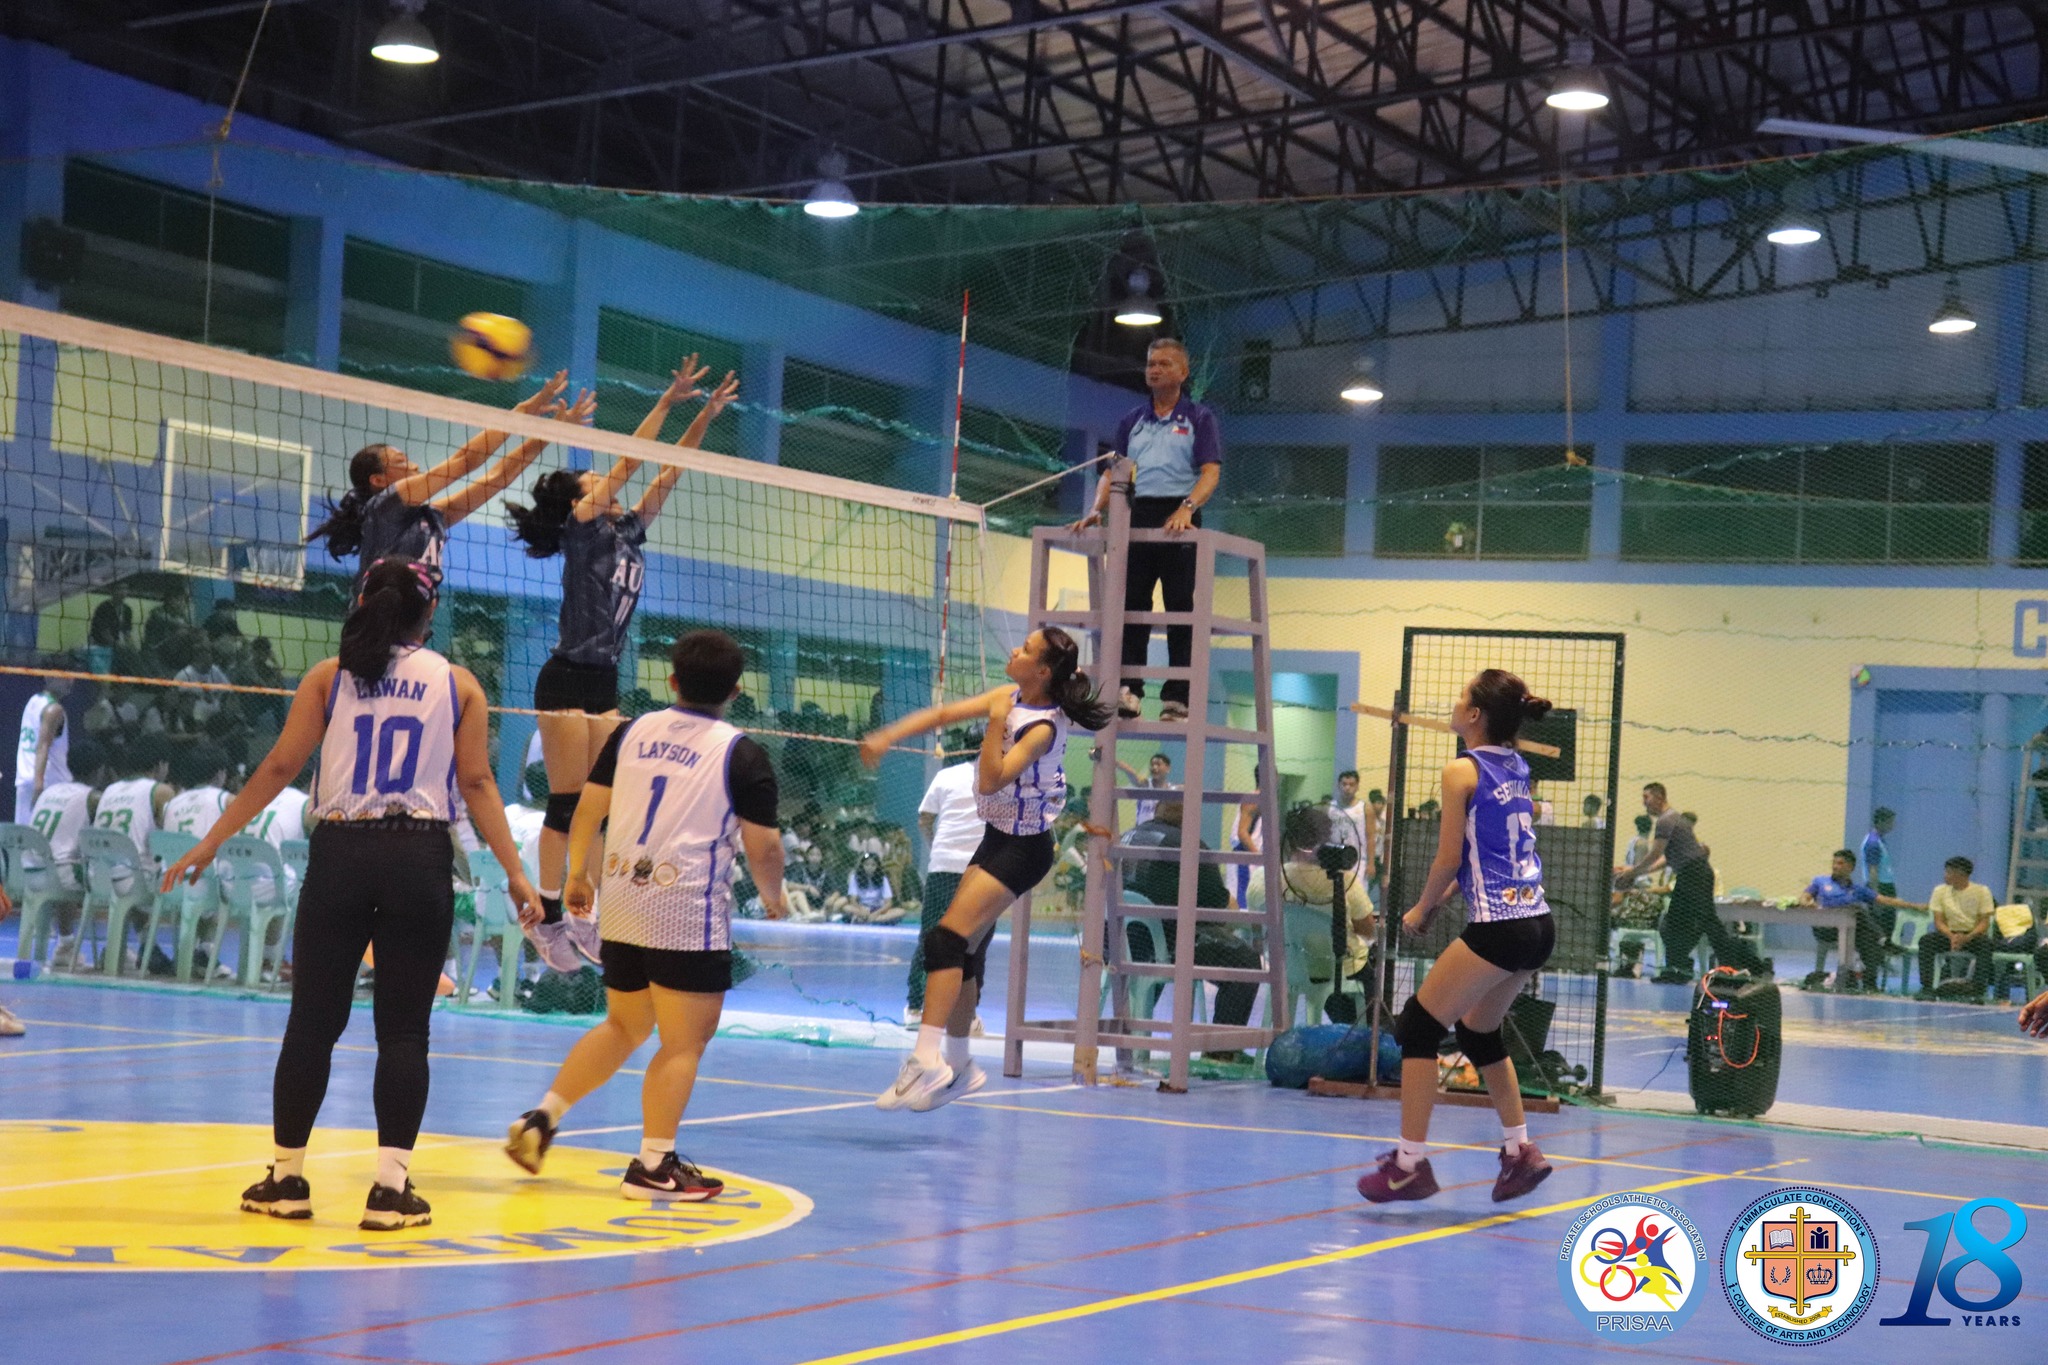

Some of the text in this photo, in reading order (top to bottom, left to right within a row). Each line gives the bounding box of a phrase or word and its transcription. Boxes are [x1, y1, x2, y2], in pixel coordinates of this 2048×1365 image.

[610, 558, 645, 593] AU
[351, 714, 425, 795] 10
[638, 741, 702, 769] LAYSON
[33, 809, 63, 840] 91
[637, 775, 668, 846] 1
[1506, 813, 1540, 880] 13
